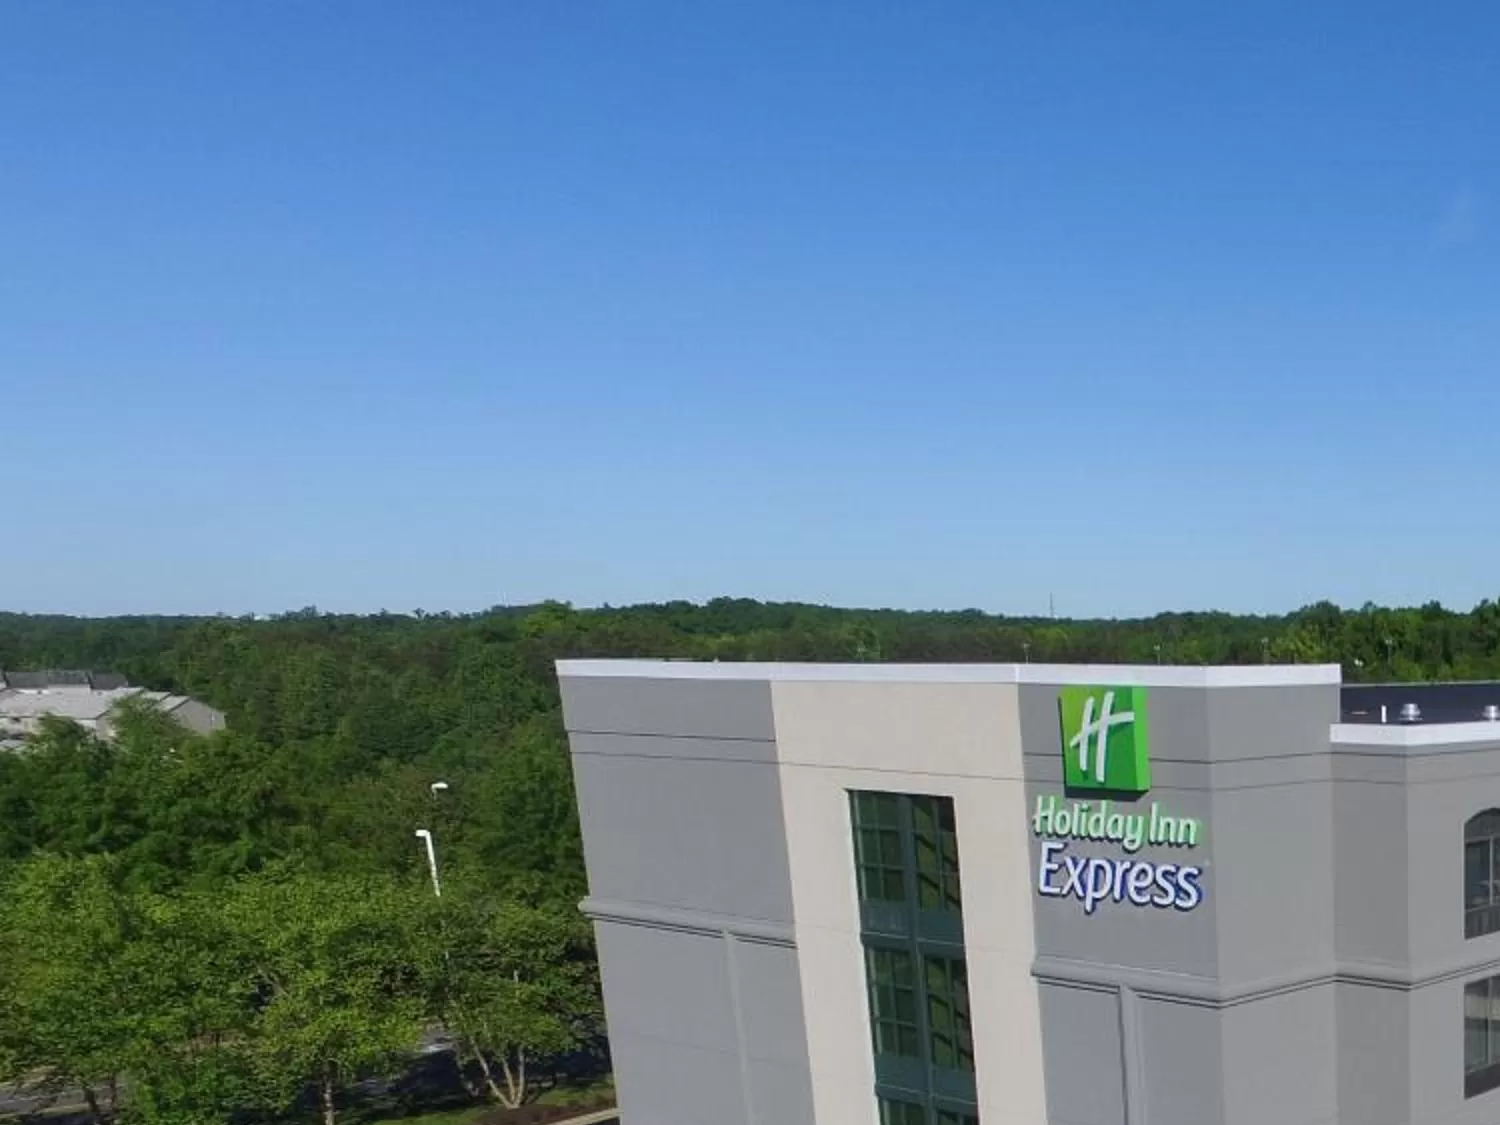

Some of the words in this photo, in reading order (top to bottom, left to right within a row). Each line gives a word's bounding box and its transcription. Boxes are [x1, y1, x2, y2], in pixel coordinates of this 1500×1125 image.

[1033, 795, 1144, 851] Holiday
[1149, 802, 1199, 846] Inn
[1039, 841, 1201, 913] Express
